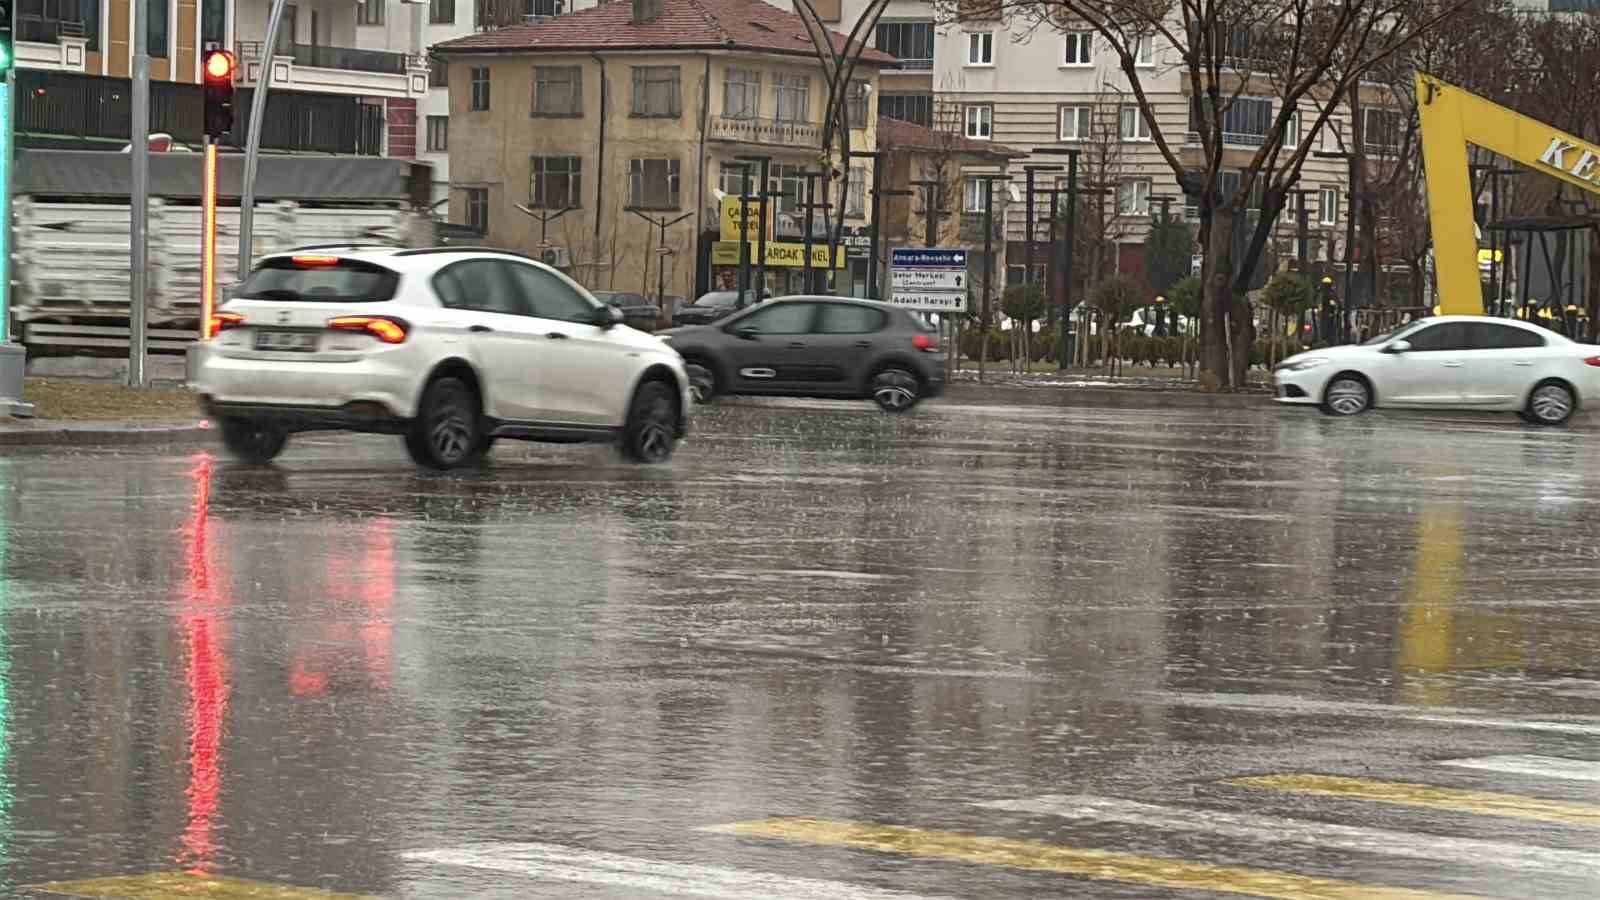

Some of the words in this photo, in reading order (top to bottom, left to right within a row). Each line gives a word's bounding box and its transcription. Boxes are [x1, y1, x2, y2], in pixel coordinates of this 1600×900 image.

[1540, 136, 1600, 186] KE
[727, 207, 762, 218] ÇADA
[763, 246, 799, 260] ARDAK
[800, 248, 828, 262] TKEL
